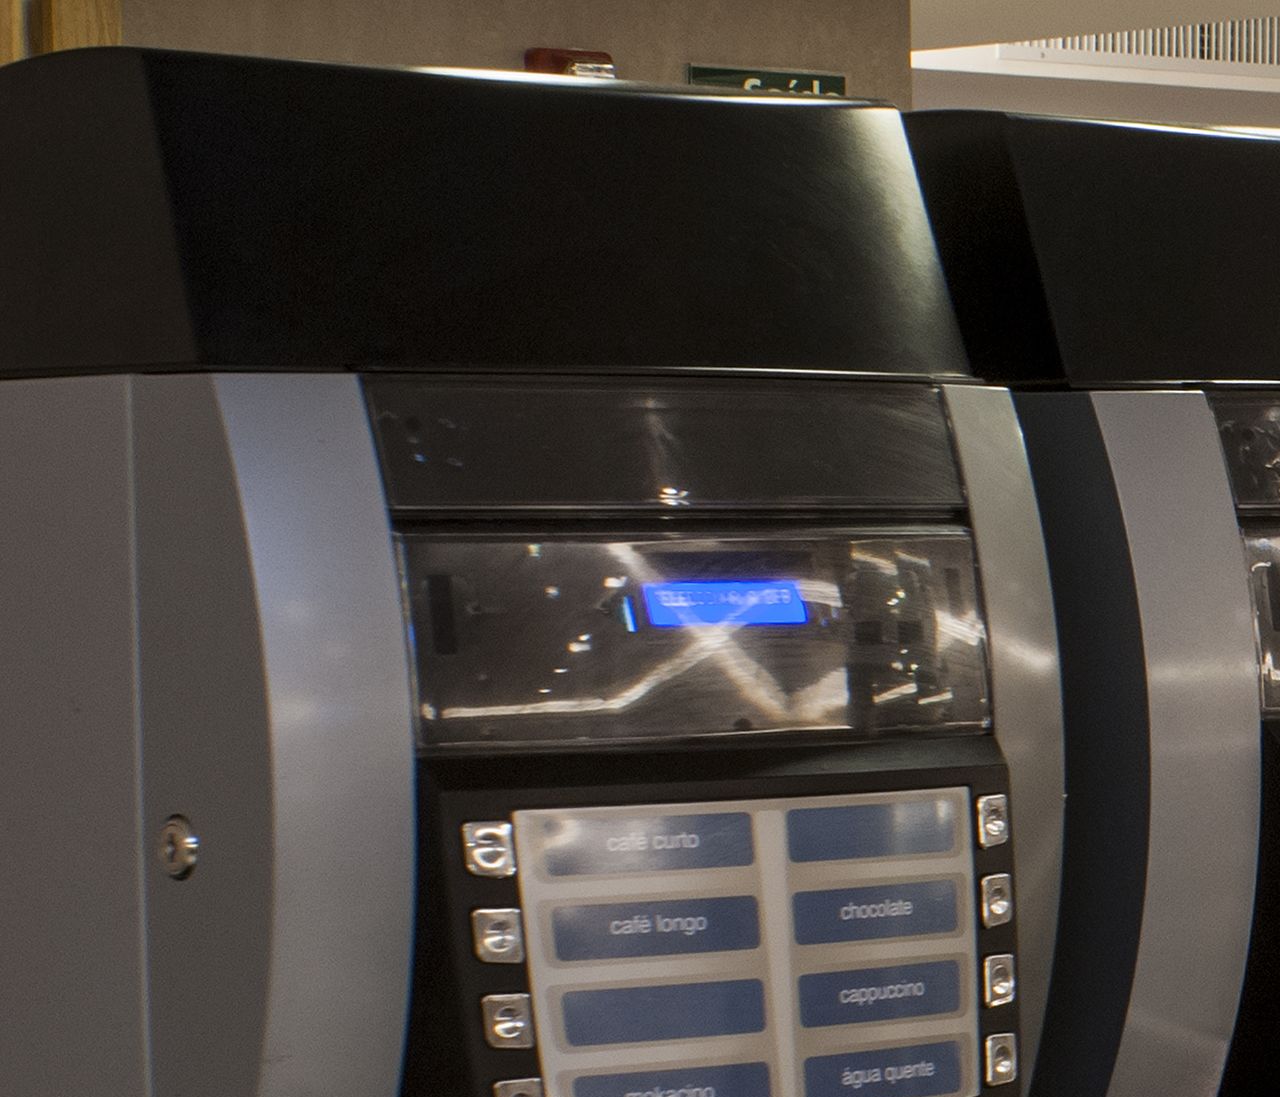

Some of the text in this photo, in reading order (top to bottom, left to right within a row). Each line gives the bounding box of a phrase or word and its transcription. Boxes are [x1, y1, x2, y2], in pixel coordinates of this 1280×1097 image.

[606, 829, 701, 852] café curto
[839, 898, 913, 922] chocolate
[609, 913, 708, 937] café longo
[838, 979, 925, 1005] cappuccino
[841, 1059, 936, 1088] água quente
